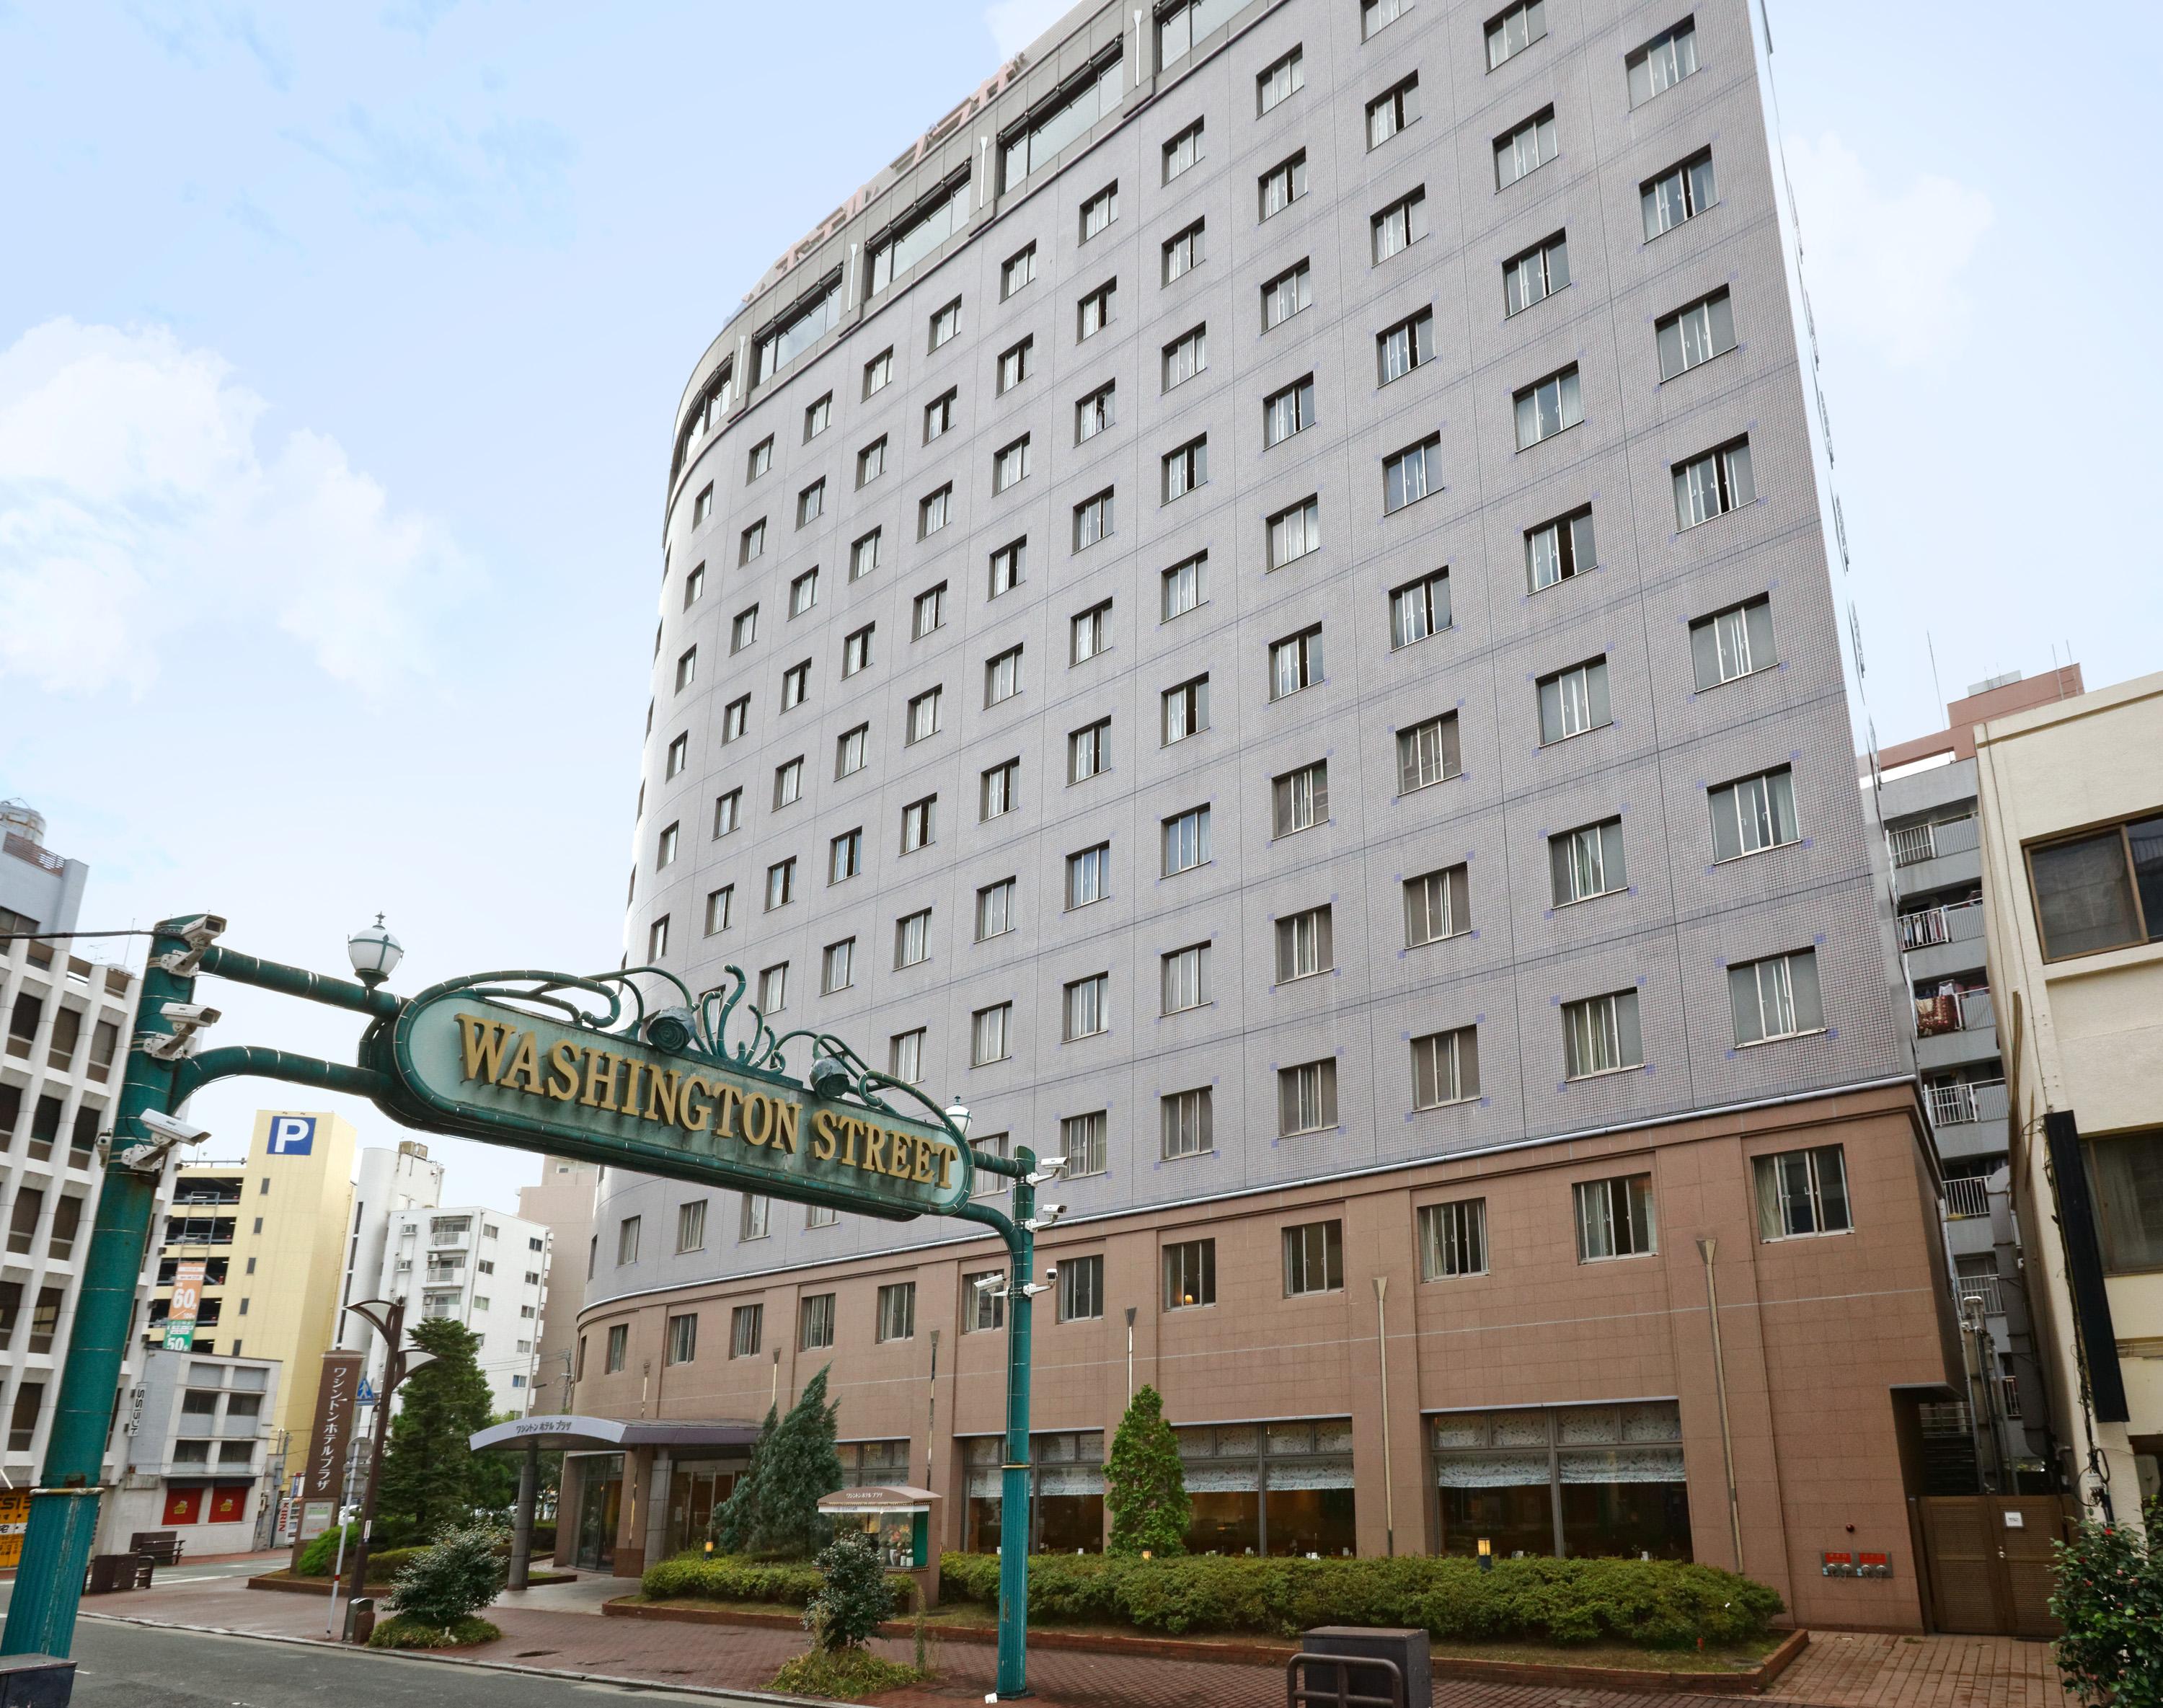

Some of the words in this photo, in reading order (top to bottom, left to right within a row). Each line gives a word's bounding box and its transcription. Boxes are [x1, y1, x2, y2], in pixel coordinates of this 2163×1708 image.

[275, 1119, 309, 1153] P
[454, 1013, 802, 1154] WASHINGTON
[810, 1109, 958, 1190] STREET
[317, 1368, 347, 1492] ワシントンホテルプラザ
[278, 1502, 289, 1532] KIRIN
